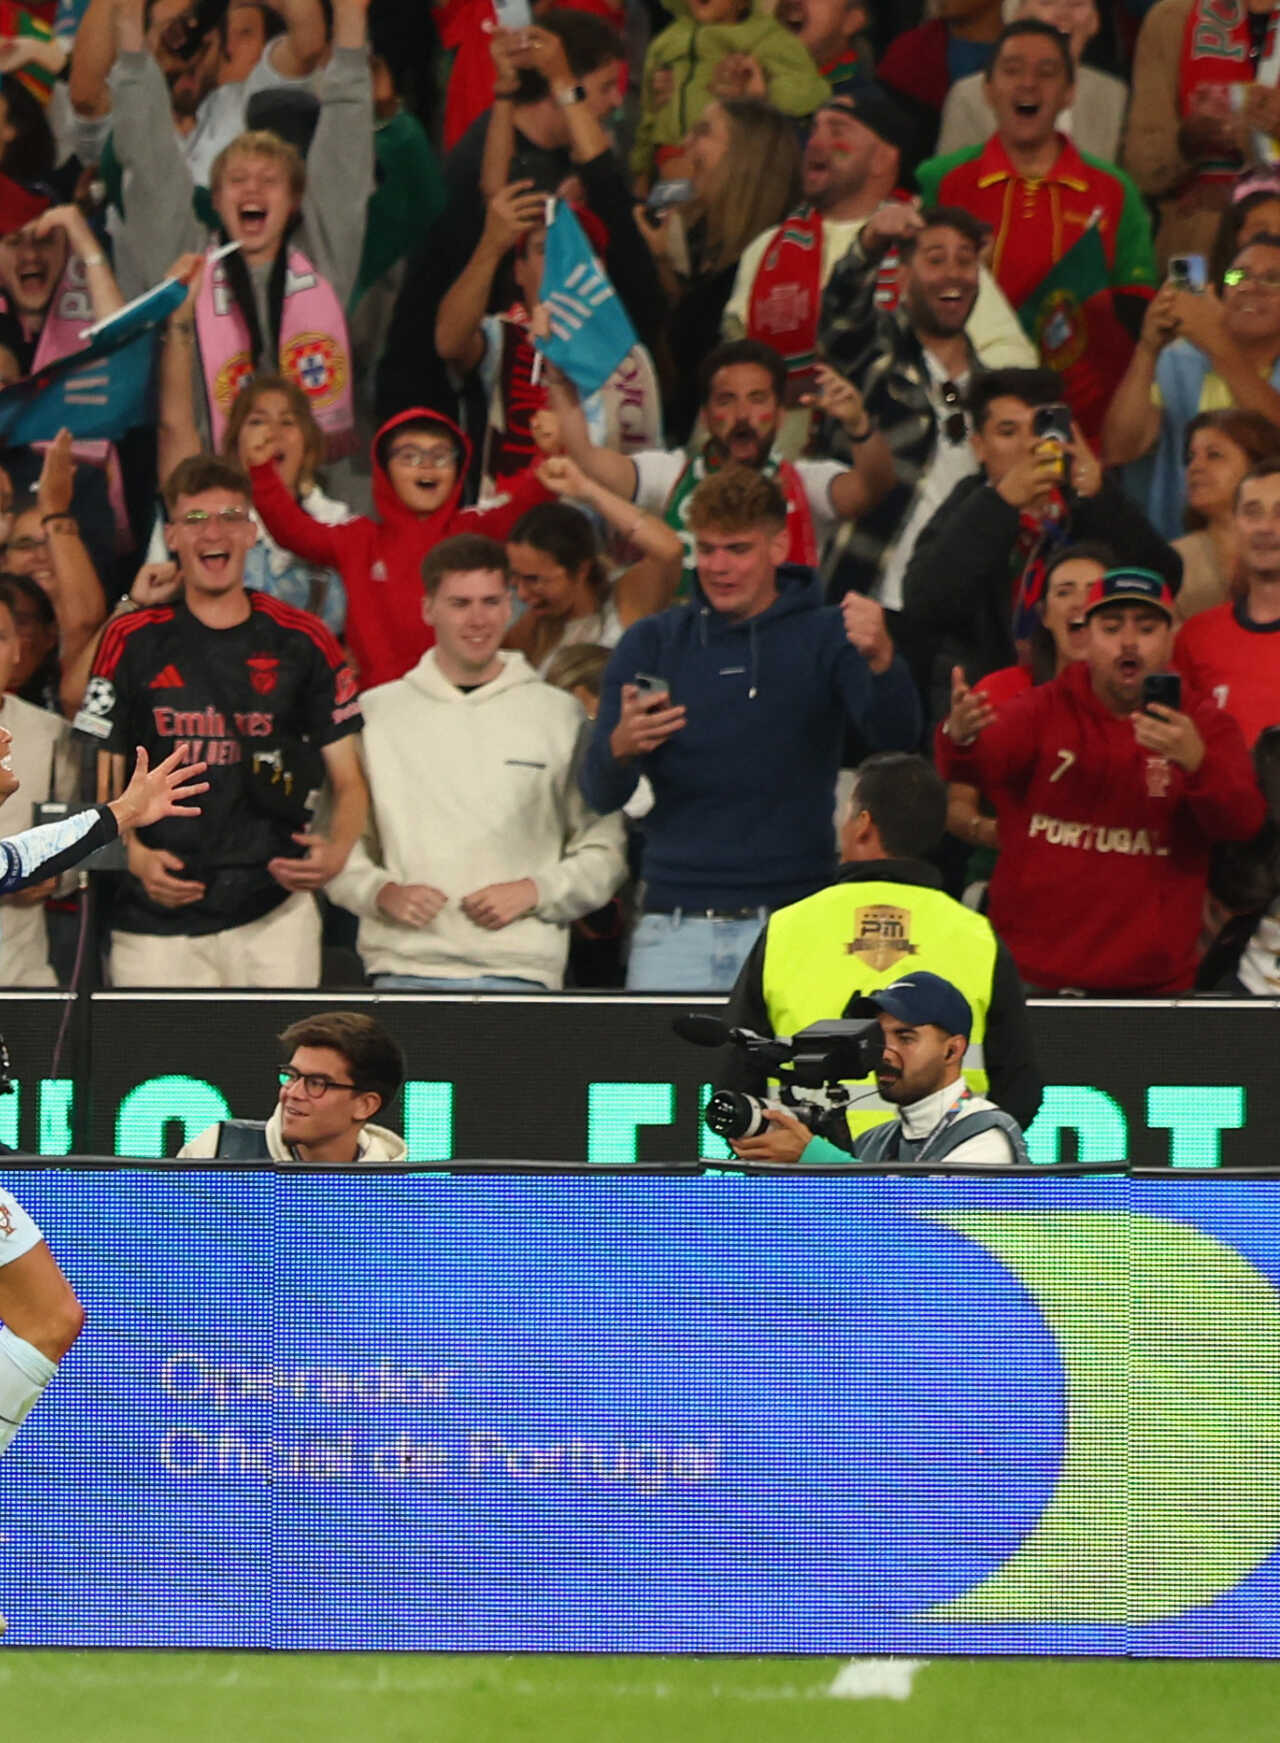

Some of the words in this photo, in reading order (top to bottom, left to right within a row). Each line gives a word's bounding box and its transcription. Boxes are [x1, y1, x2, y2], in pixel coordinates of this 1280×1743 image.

[1049, 749, 1076, 783] 7
[160, 1352, 458, 1410] Operador
[372, 1430, 451, 1480] de
[468, 1430, 722, 1494] Portugal
